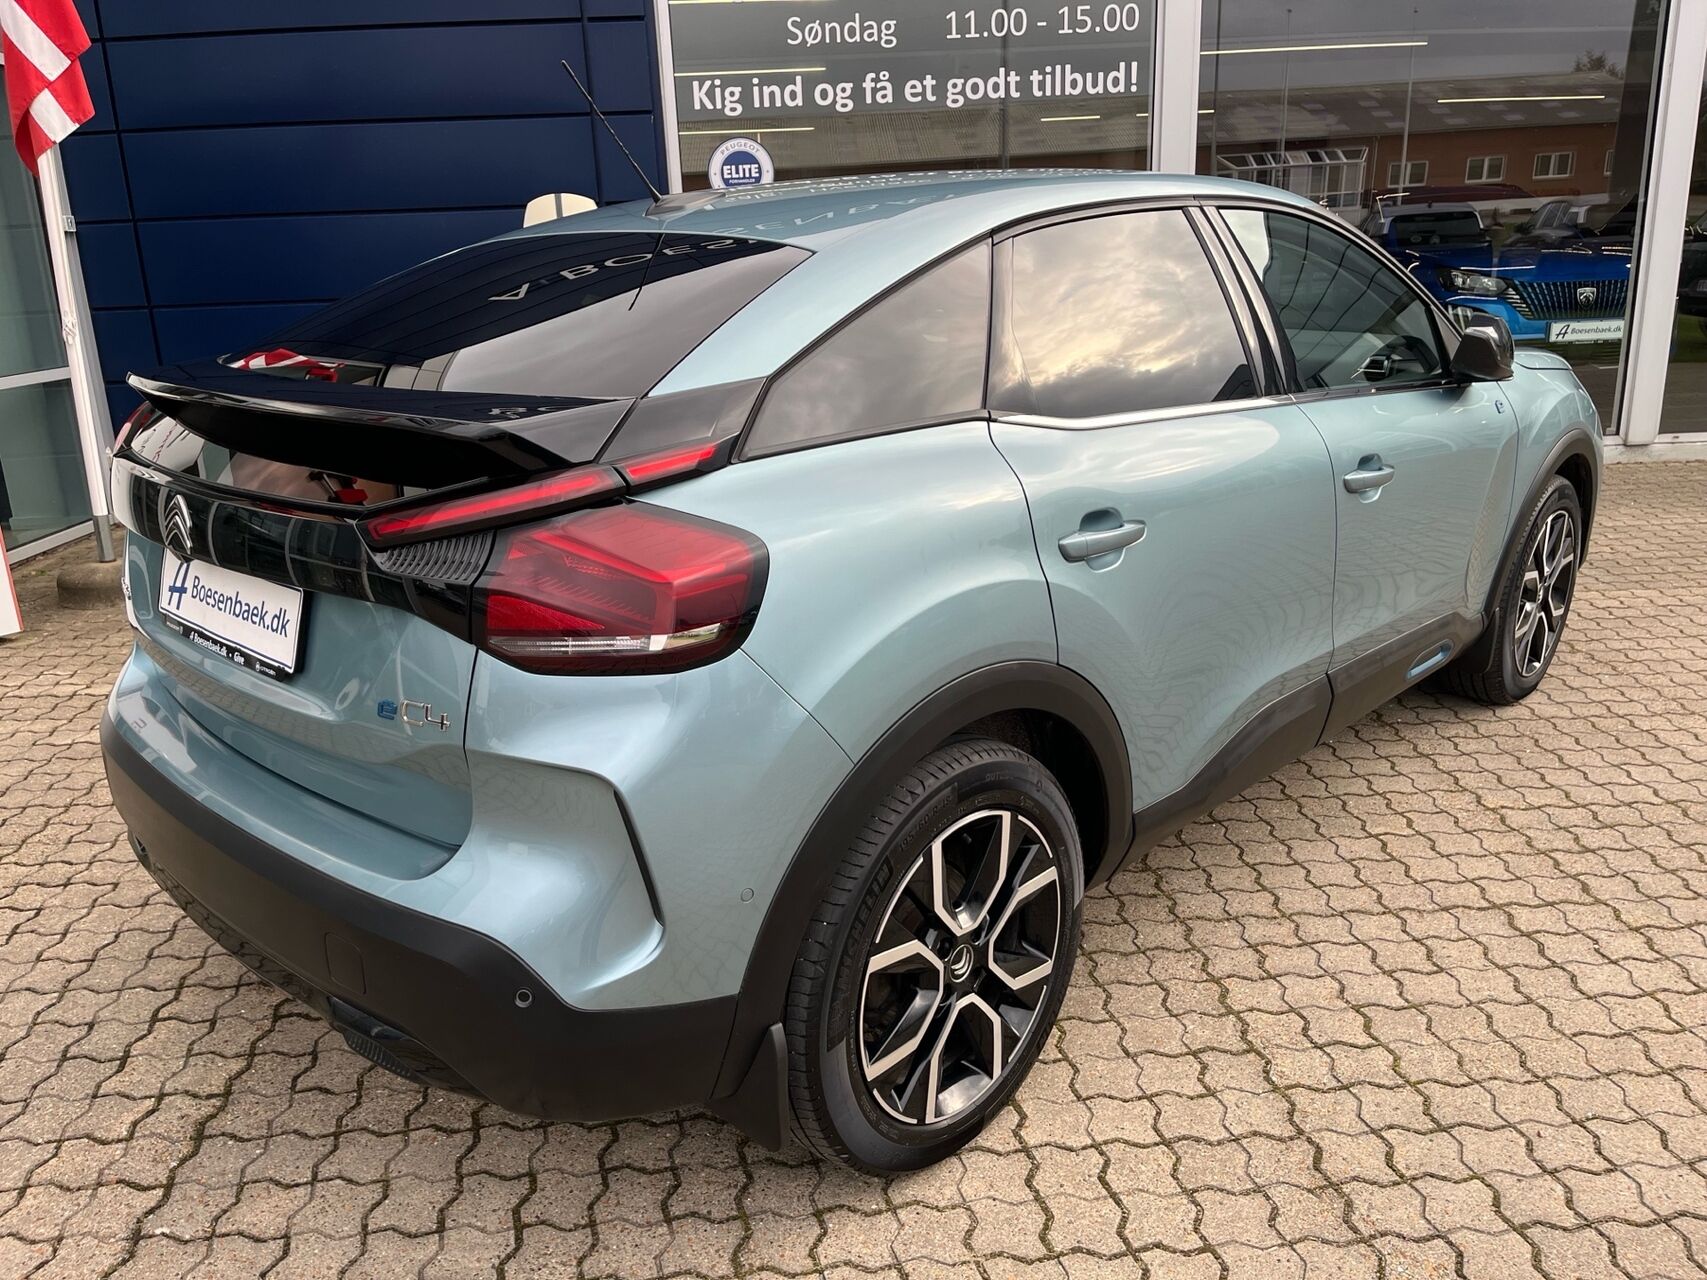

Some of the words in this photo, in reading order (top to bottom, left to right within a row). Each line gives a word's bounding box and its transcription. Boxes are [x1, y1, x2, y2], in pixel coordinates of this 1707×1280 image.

[785, 12, 898, 48] Søndag
[946, 6, 1027, 40] 11.00
[1057, 2, 1141, 36] 15.00
[691, 78, 743, 117] Kig
[752, 75, 803, 109] ind
[813, 82, 854, 113] og
[861, 70, 894, 105] få
[903, 74, 937, 104] et
[945, 66, 1022, 109] godt
[1028, 60, 1139, 99] tilbud!
[719, 141, 761, 156] PEUGEOT
[722, 163, 760, 179] ELITE
[1570, 325, 1623, 335] Boesenbaek.dk
[191, 575, 290, 638] Boesenbaek.dk
[194, 630, 227, 658] Boesenbaek.dk
[233, 651, 245, 665] Give
